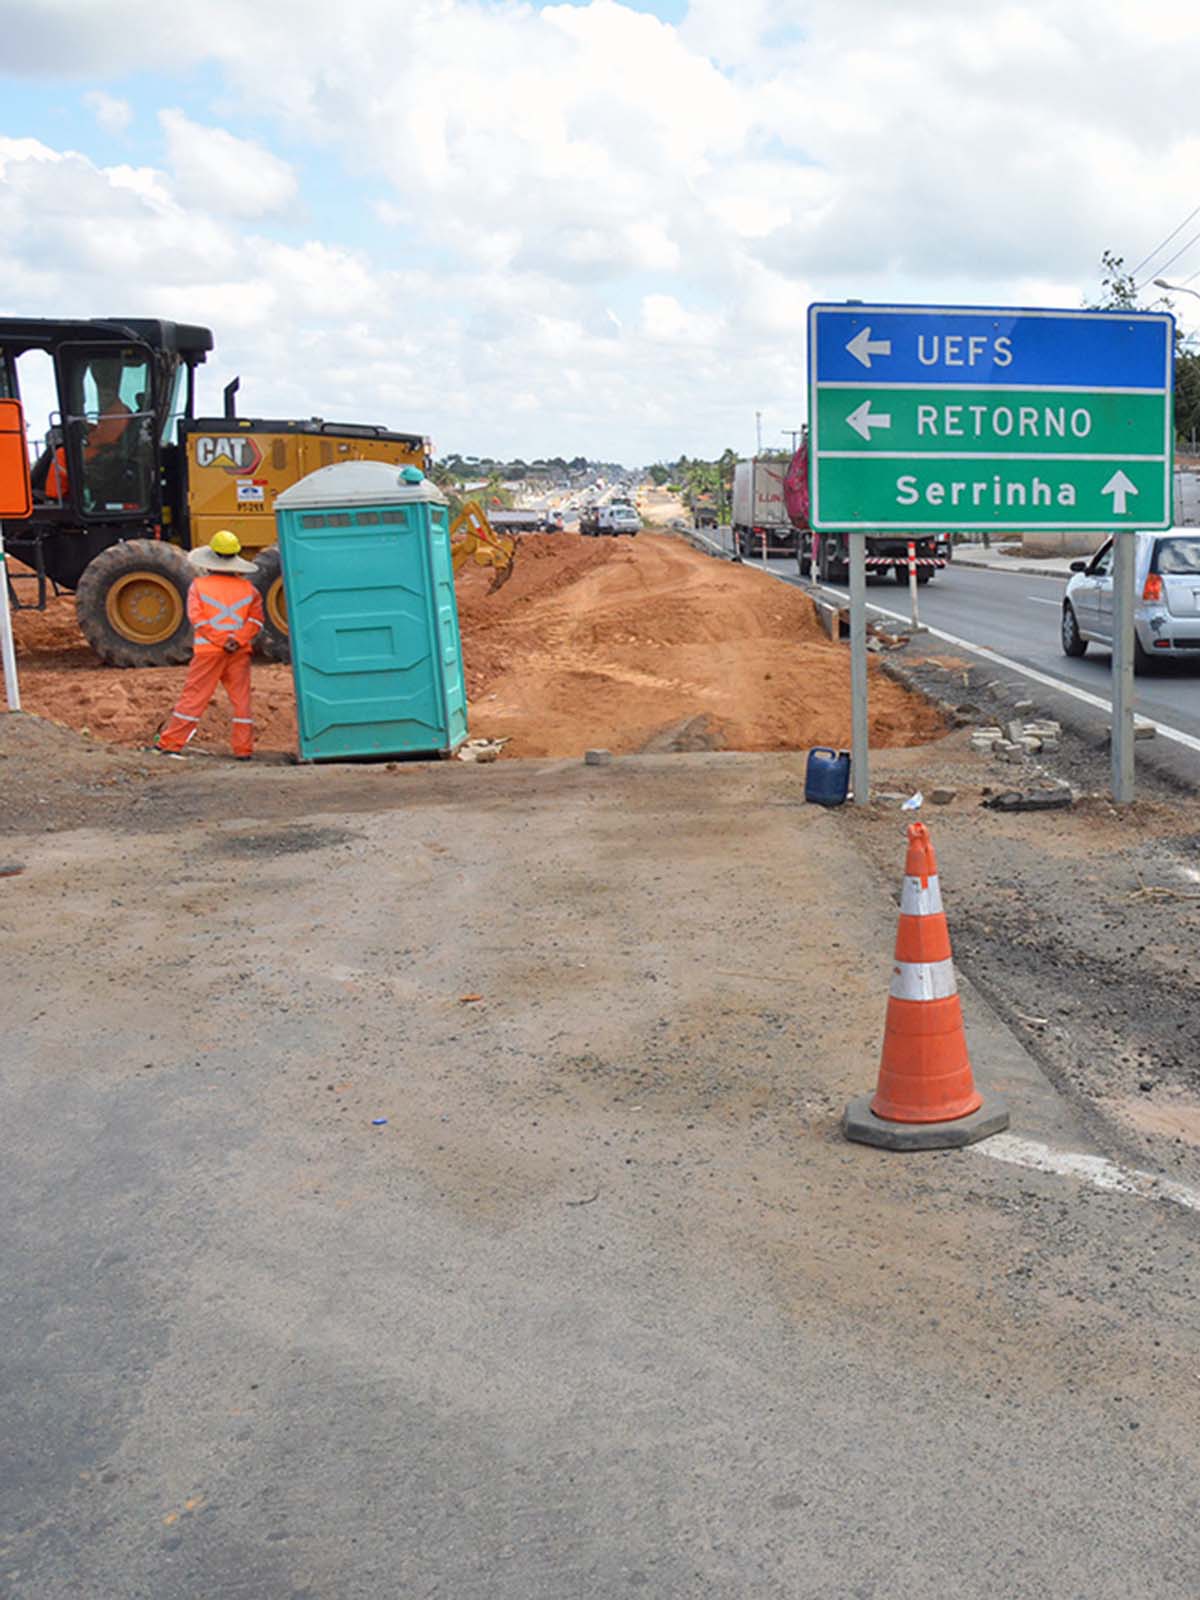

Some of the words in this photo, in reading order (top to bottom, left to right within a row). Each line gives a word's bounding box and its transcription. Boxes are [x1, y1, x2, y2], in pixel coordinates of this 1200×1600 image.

[917, 335, 1013, 367] UEFS
[917, 405, 1092, 438] RETORNO
[197, 437, 247, 468] CAT
[896, 475, 1077, 506] Serrinha
